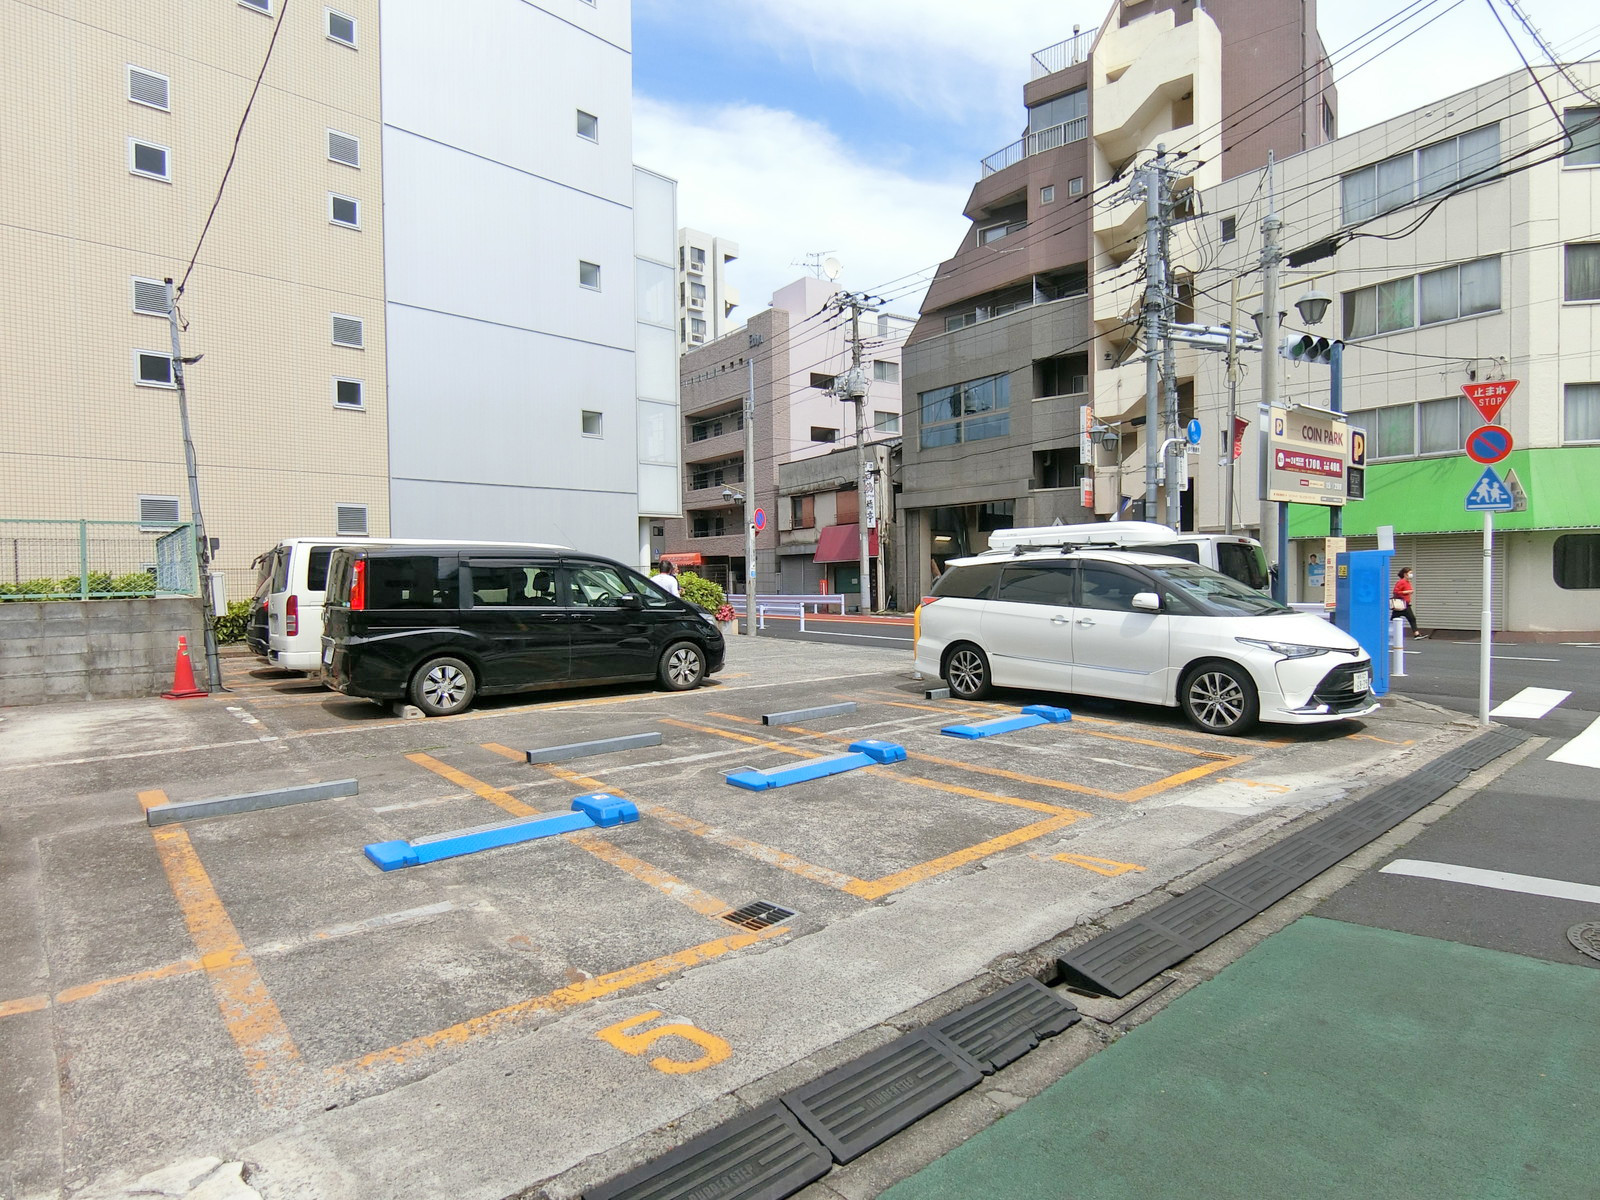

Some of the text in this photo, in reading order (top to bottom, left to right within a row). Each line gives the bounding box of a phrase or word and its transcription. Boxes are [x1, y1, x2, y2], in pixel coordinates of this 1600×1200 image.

[1473, 385, 1508, 398] 止まれ
[1478, 397, 1503, 407] STOP
[1302, 425, 1344, 446] COIN PARK
[595, 1009, 734, 1075] 5
